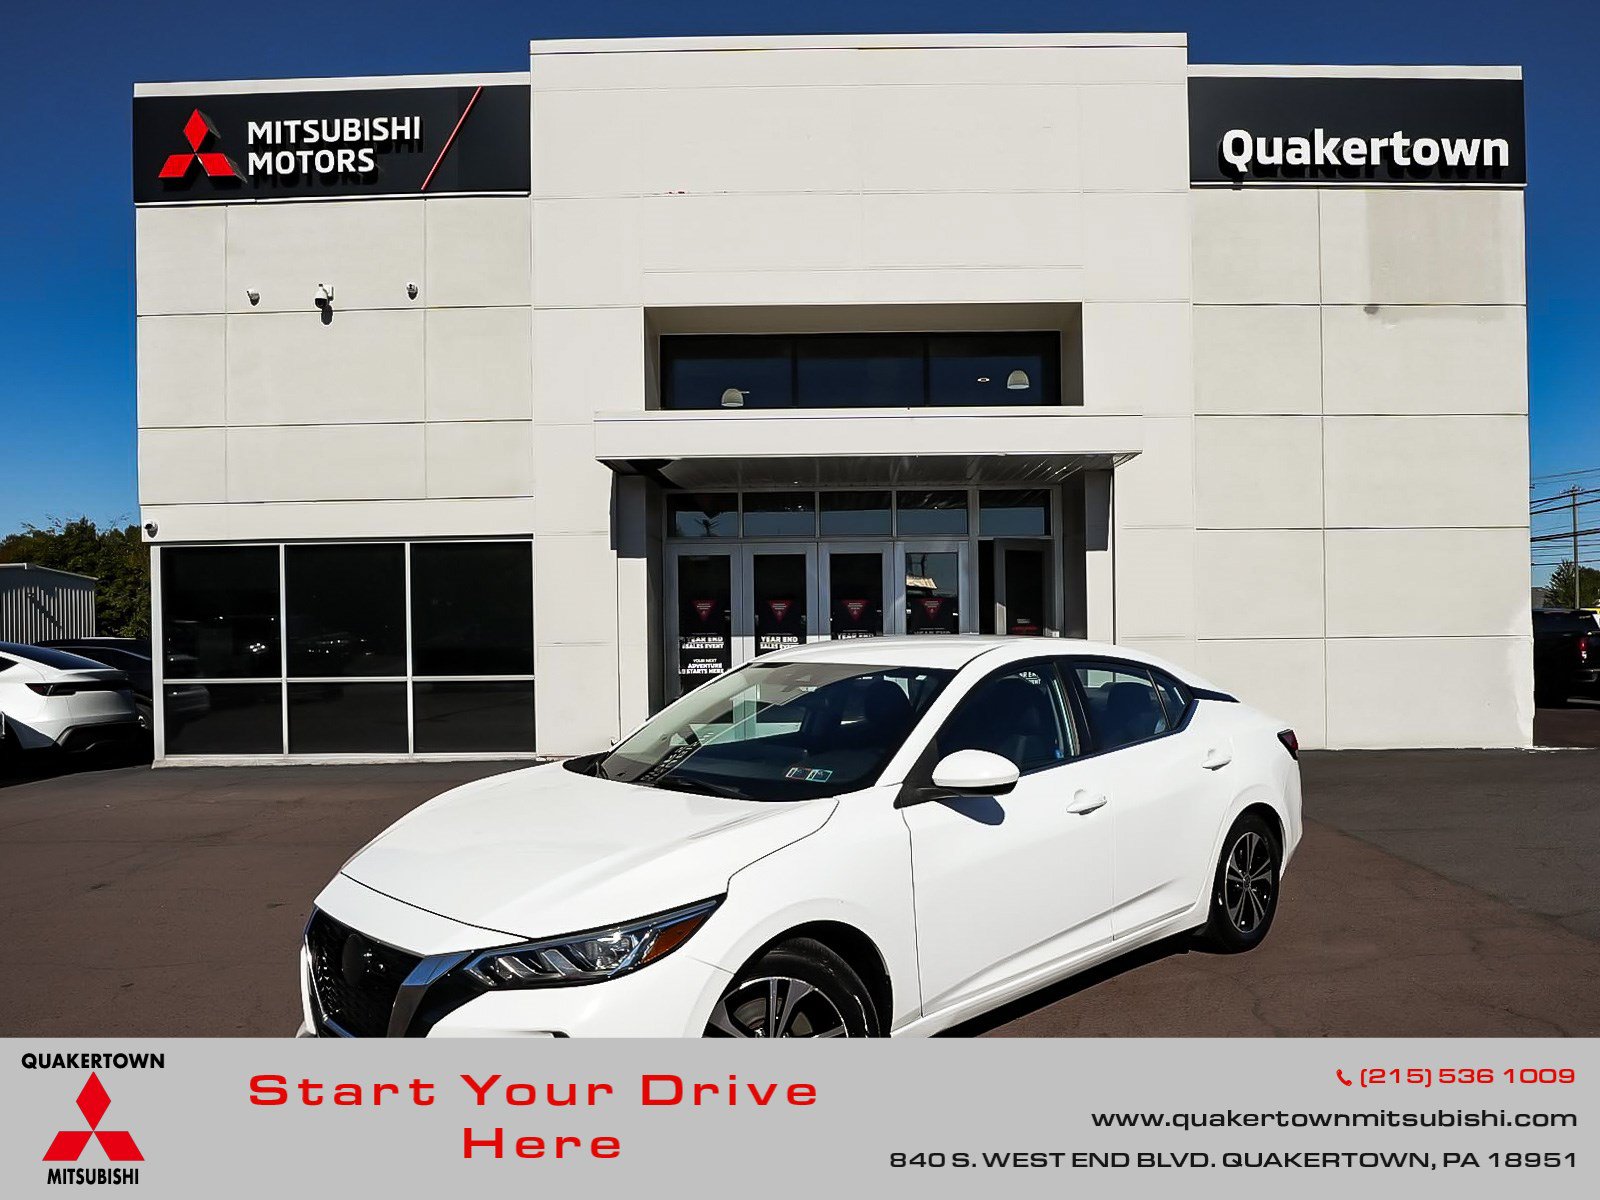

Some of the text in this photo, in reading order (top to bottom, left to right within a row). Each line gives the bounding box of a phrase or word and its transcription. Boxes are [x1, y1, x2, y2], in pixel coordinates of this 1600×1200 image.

[248, 116, 420, 145] MITSUBISHI
[248, 148, 376, 176] MOTORS
[1222, 128, 1509, 173] Quakertown
